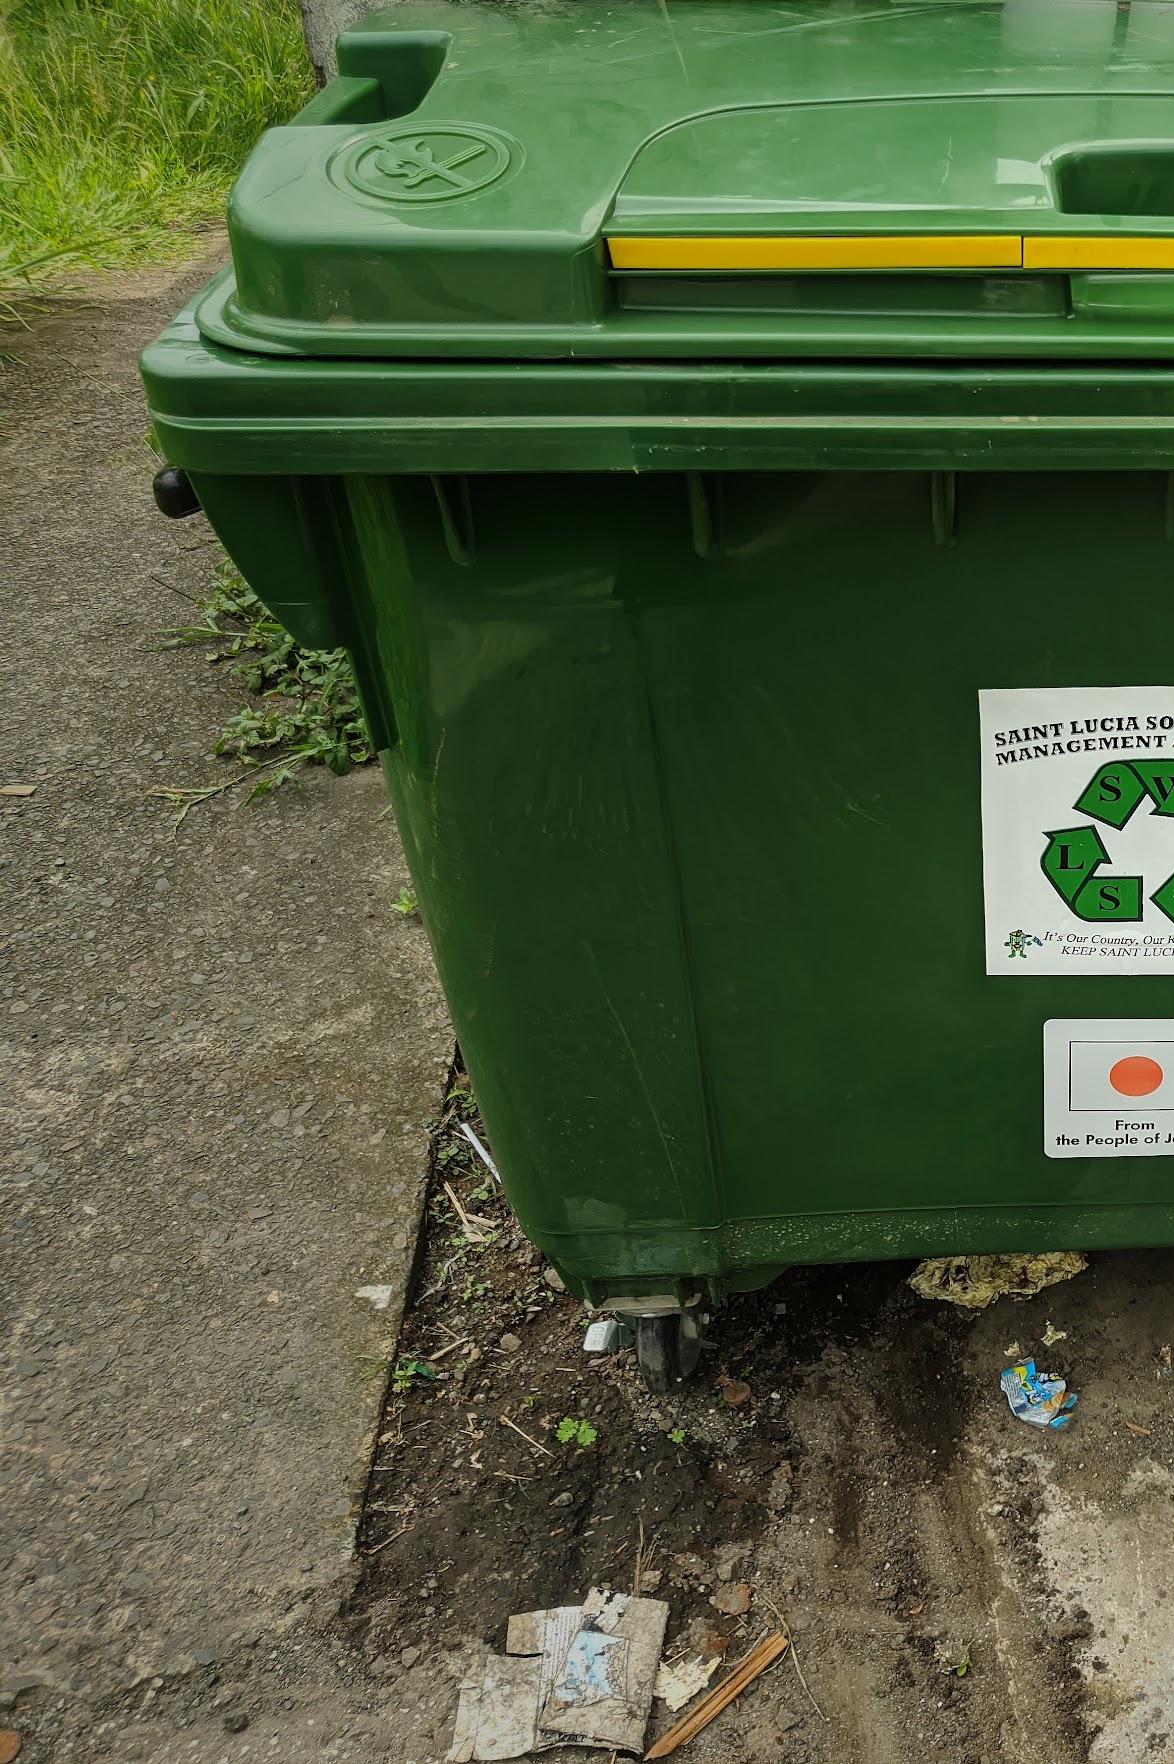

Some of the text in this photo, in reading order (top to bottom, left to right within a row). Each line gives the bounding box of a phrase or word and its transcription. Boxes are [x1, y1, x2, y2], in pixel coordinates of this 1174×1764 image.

[994, 722, 1064, 748] SAINT
[1070, 716, 1140, 736] LUCIA
[995, 735, 1167, 766] MANAGEMENT
[1099, 775, 1122, 802] S
[1056, 844, 1085, 871] L
[1099, 884, 1121, 911] S
[1043, 931, 1064, 942] It's
[1066, 933, 1088, 943] Our
[1091, 934, 1139, 947] Country,
[1143, 935, 1165, 945] Our
[1061, 946, 1097, 956] KEEP
[1099, 947, 1141, 957] SAINT
[1115, 1119, 1155, 1131] From
[1056, 1134, 1080, 1146] the
[1086, 1133, 1139, 1148] People
[1144, 1133, 1160, 1144] of
